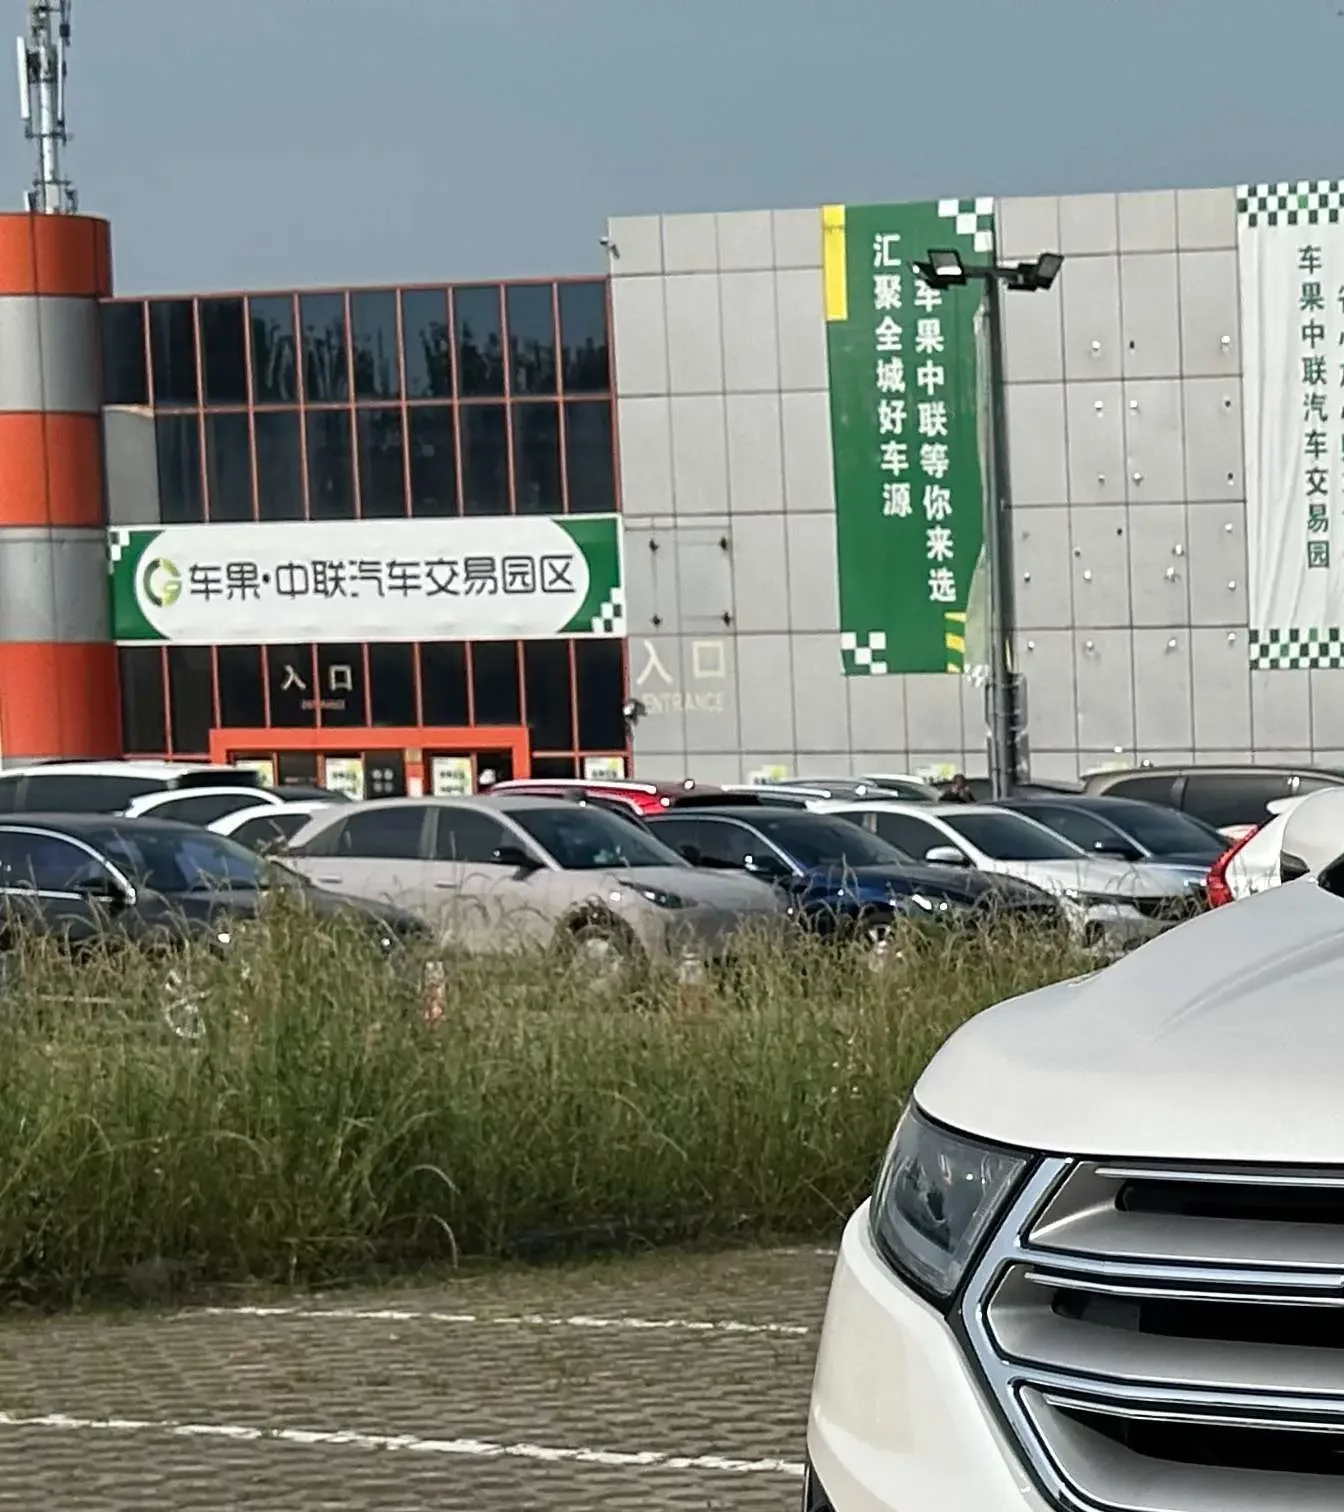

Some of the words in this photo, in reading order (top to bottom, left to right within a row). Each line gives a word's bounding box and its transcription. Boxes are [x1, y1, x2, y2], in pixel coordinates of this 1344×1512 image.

[873, 234, 913, 517] 汇聚全城好车源
[914, 278, 957, 602] 车果中联等你来选
[1298, 245, 1330, 569] 车果中联汽车交易园
[281, 664, 353, 691] 入口
[636, 640, 726, 686] 入口
